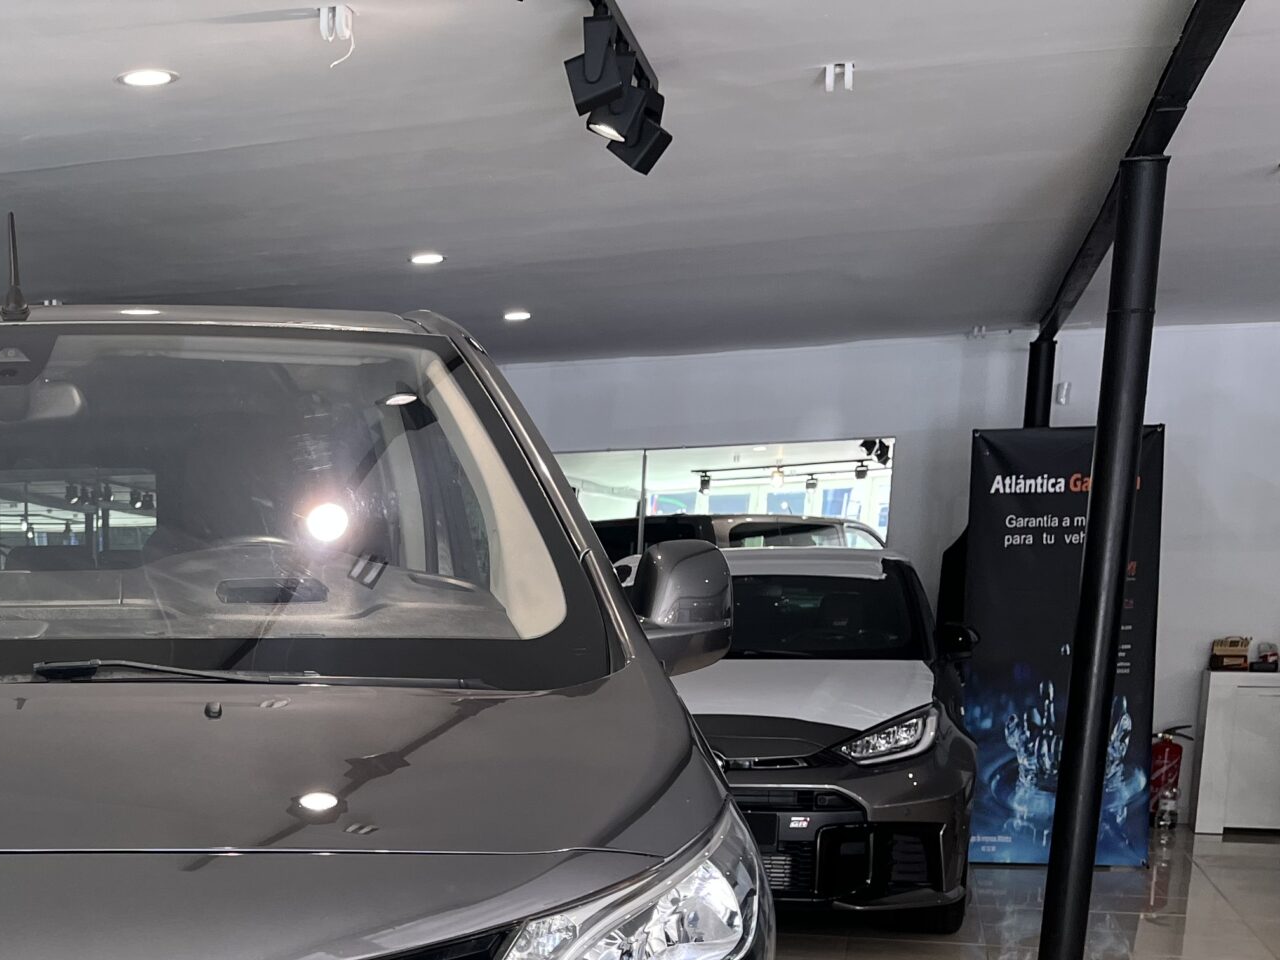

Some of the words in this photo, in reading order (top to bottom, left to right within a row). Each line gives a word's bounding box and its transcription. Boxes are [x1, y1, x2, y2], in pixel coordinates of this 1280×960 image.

[989, 474, 1066, 494] Atlántica
[1005, 514, 1059, 528] Garantía
[1062, 516, 1070, 527] a
[1004, 534, 1033, 549] para
[1042, 532, 1055, 544] tu
